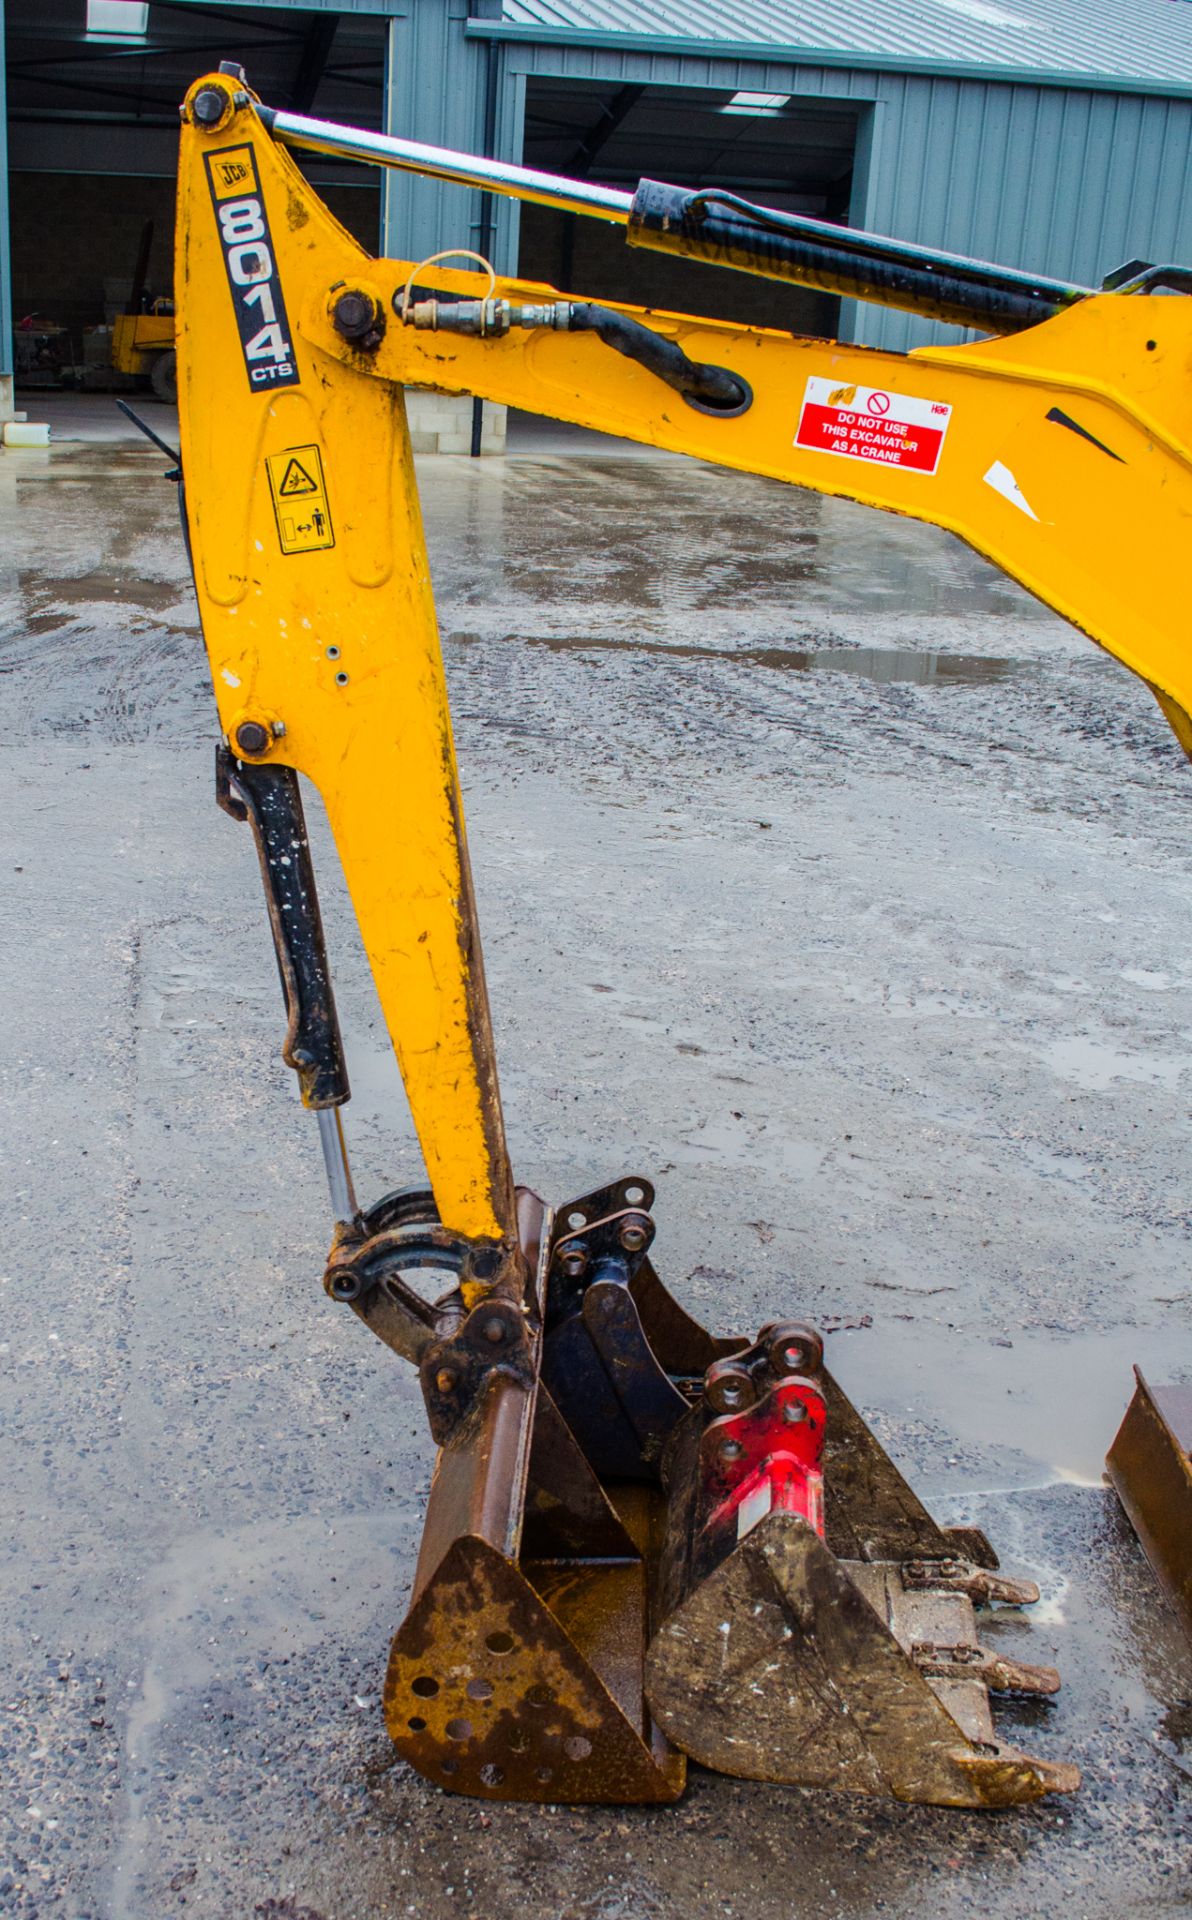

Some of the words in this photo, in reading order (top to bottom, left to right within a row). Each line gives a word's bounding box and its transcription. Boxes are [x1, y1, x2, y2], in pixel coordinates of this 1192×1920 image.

[221, 164, 247, 185] JCB
[219, 199, 290, 362] 8014
[251, 363, 293, 381] CTS
[822, 423, 848, 437] THIS
[837, 412, 856, 424] DO
[857, 418, 883, 430] NOT
[884, 422, 908, 436] USE
[831, 440, 848, 452] AS
[849, 443, 859, 454] A
[861, 446, 901, 462] CRANE
